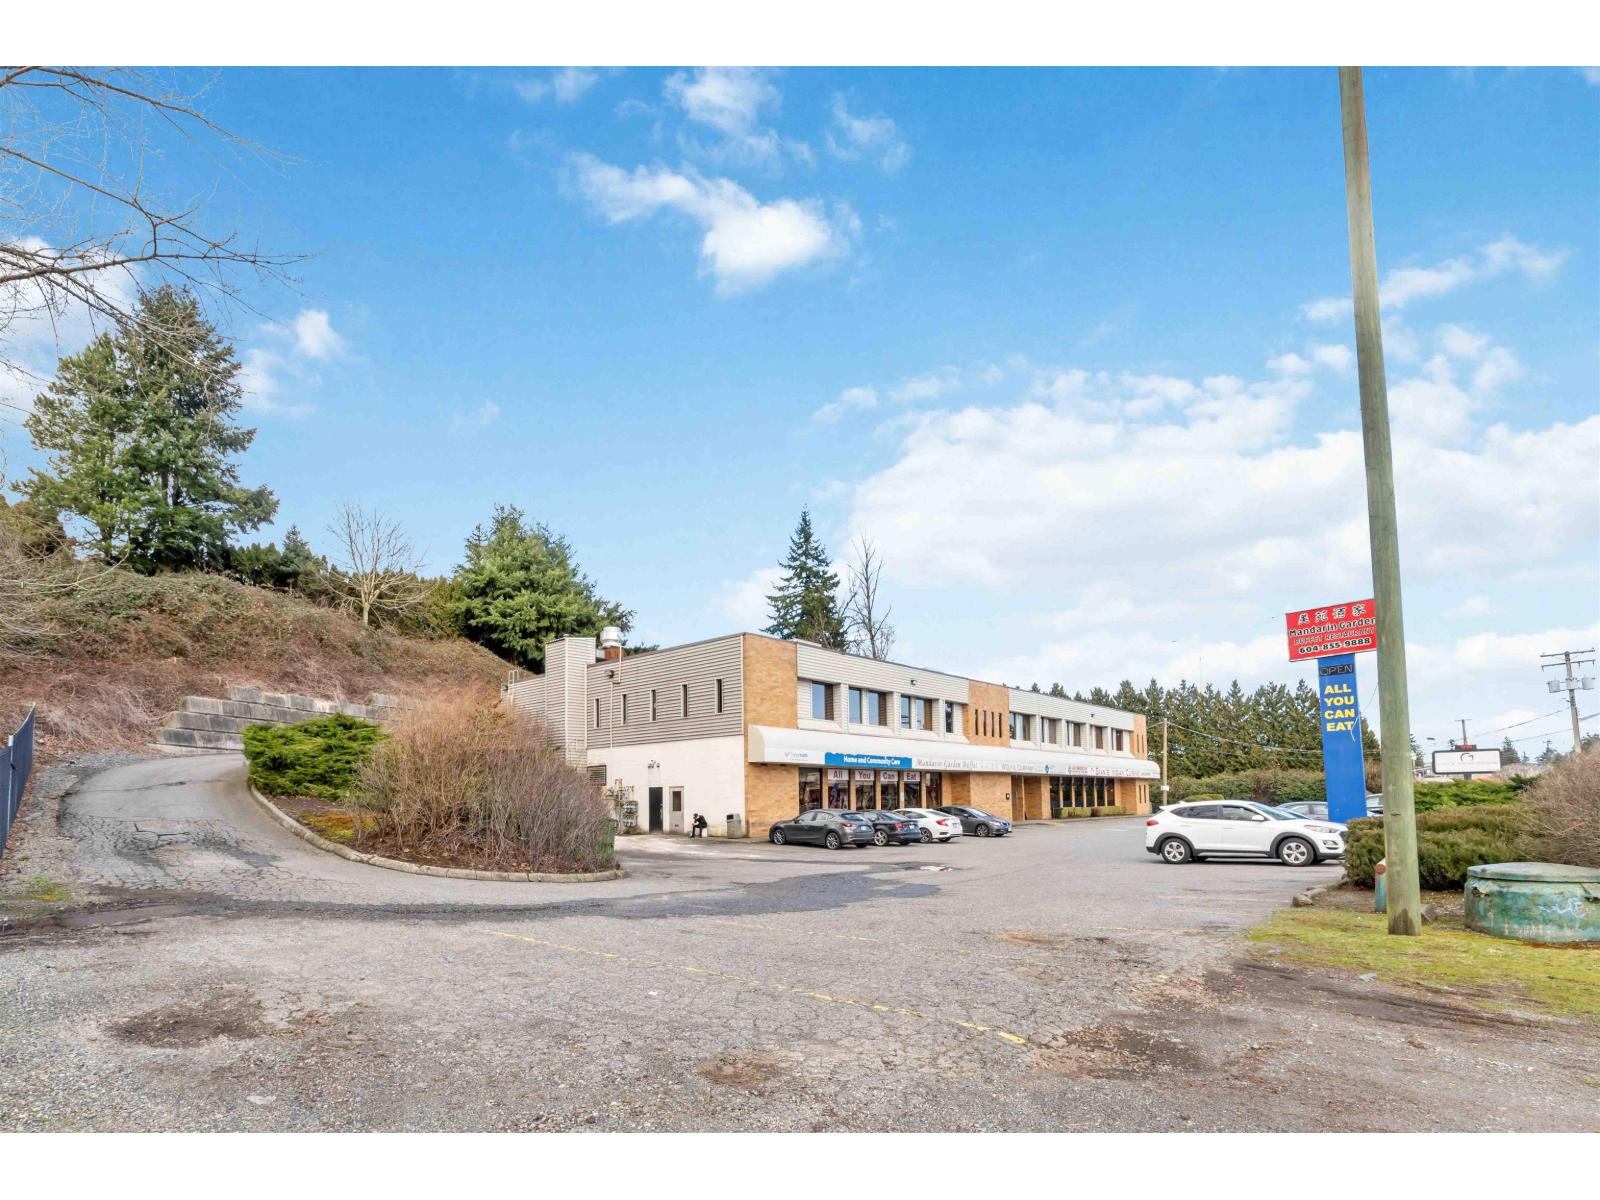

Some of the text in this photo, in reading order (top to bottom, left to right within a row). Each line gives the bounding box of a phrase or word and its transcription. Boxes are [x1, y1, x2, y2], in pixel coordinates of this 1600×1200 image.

[1289, 617, 1376, 637] Mandarin Garden
[1299, 637, 1371, 654] 604-855-9888
[1320, 664, 1353, 676] OPEN
[1324, 683, 1352, 695] ALL
[1324, 695, 1355, 707] YOU
[1324, 708, 1356, 719] CAN
[1326, 721, 1354, 732] EAT
[843, 755, 857, 764] Home
[857, 756, 867, 764] and
[867, 757, 891, 766] Community
[833, 769, 917, 780] All You Can Eat
